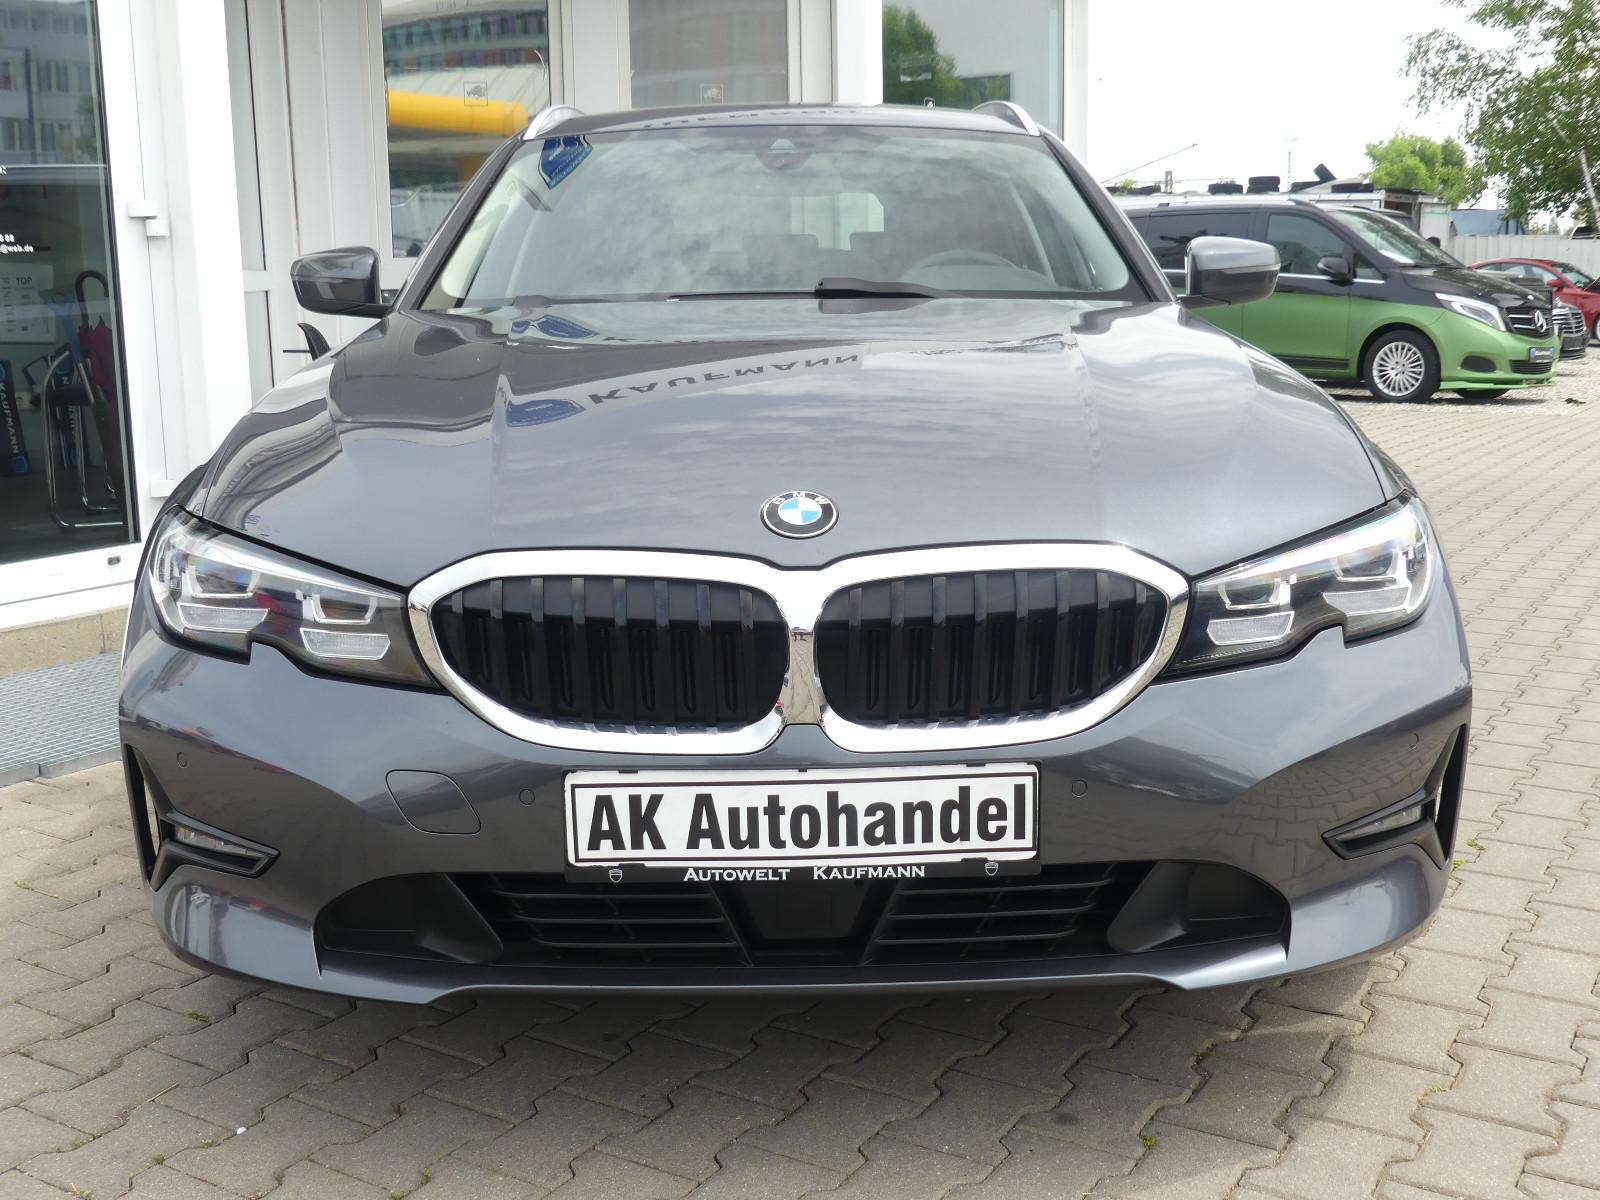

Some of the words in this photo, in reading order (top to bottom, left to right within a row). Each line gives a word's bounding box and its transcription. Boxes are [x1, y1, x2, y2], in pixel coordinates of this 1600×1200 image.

[771, 491, 830, 505] BMW
[587, 793, 666, 850] AK
[686, 783, 1026, 850] Autohandel
[683, 867, 791, 882] AUTOWELT
[813, 865, 925, 880] KAUFMANN
